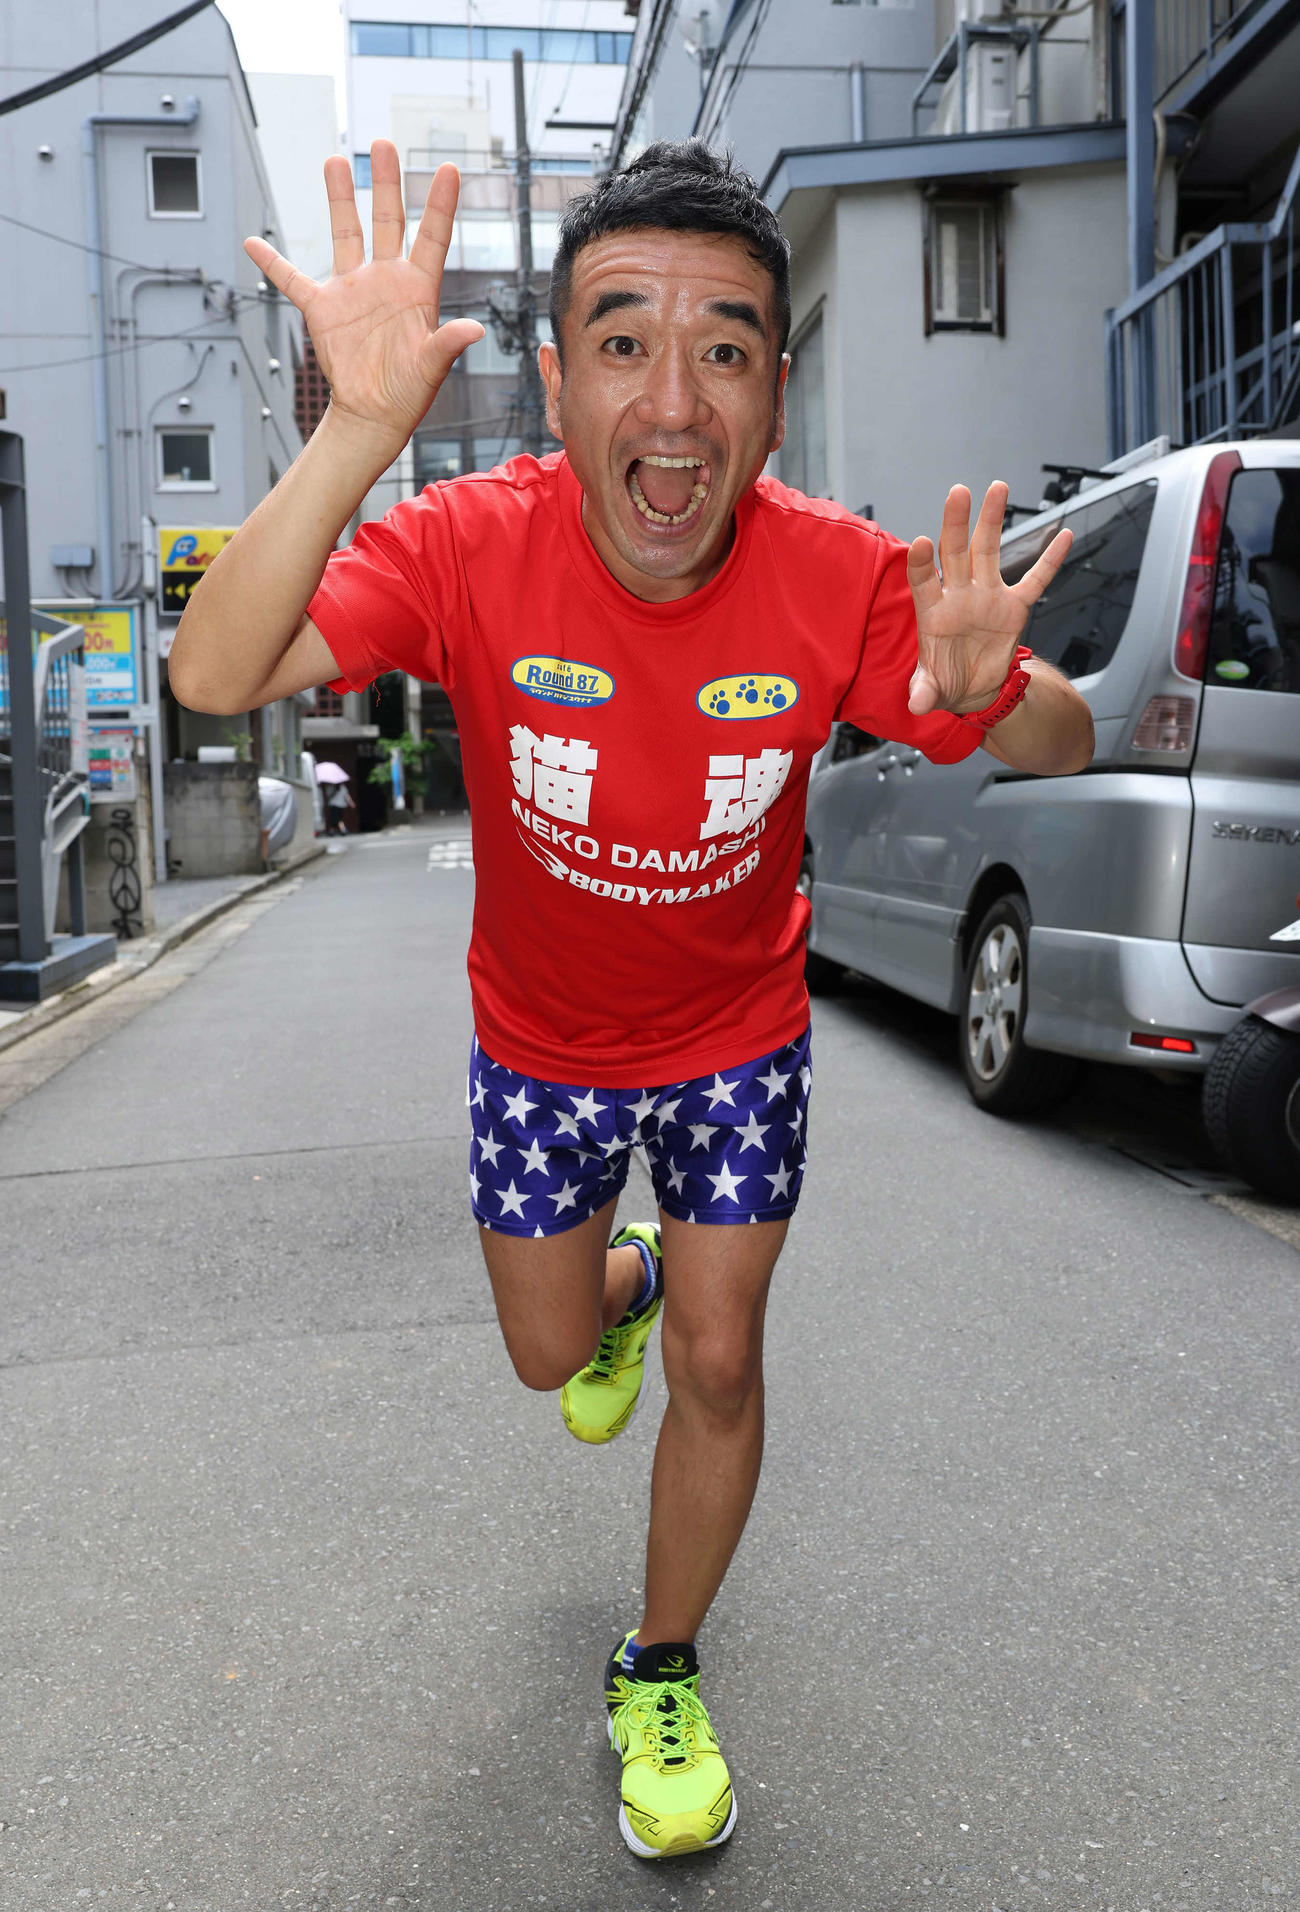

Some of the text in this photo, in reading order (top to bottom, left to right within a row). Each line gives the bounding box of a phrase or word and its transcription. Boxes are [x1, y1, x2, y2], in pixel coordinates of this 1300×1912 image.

[526, 664, 599, 691] Round 87
[509, 724, 793, 840] 猫 魂
[511, 798, 600, 860] NEKO
[611, 816, 766, 873] DAMASHI
[568, 849, 761, 905] BODYMAKER
